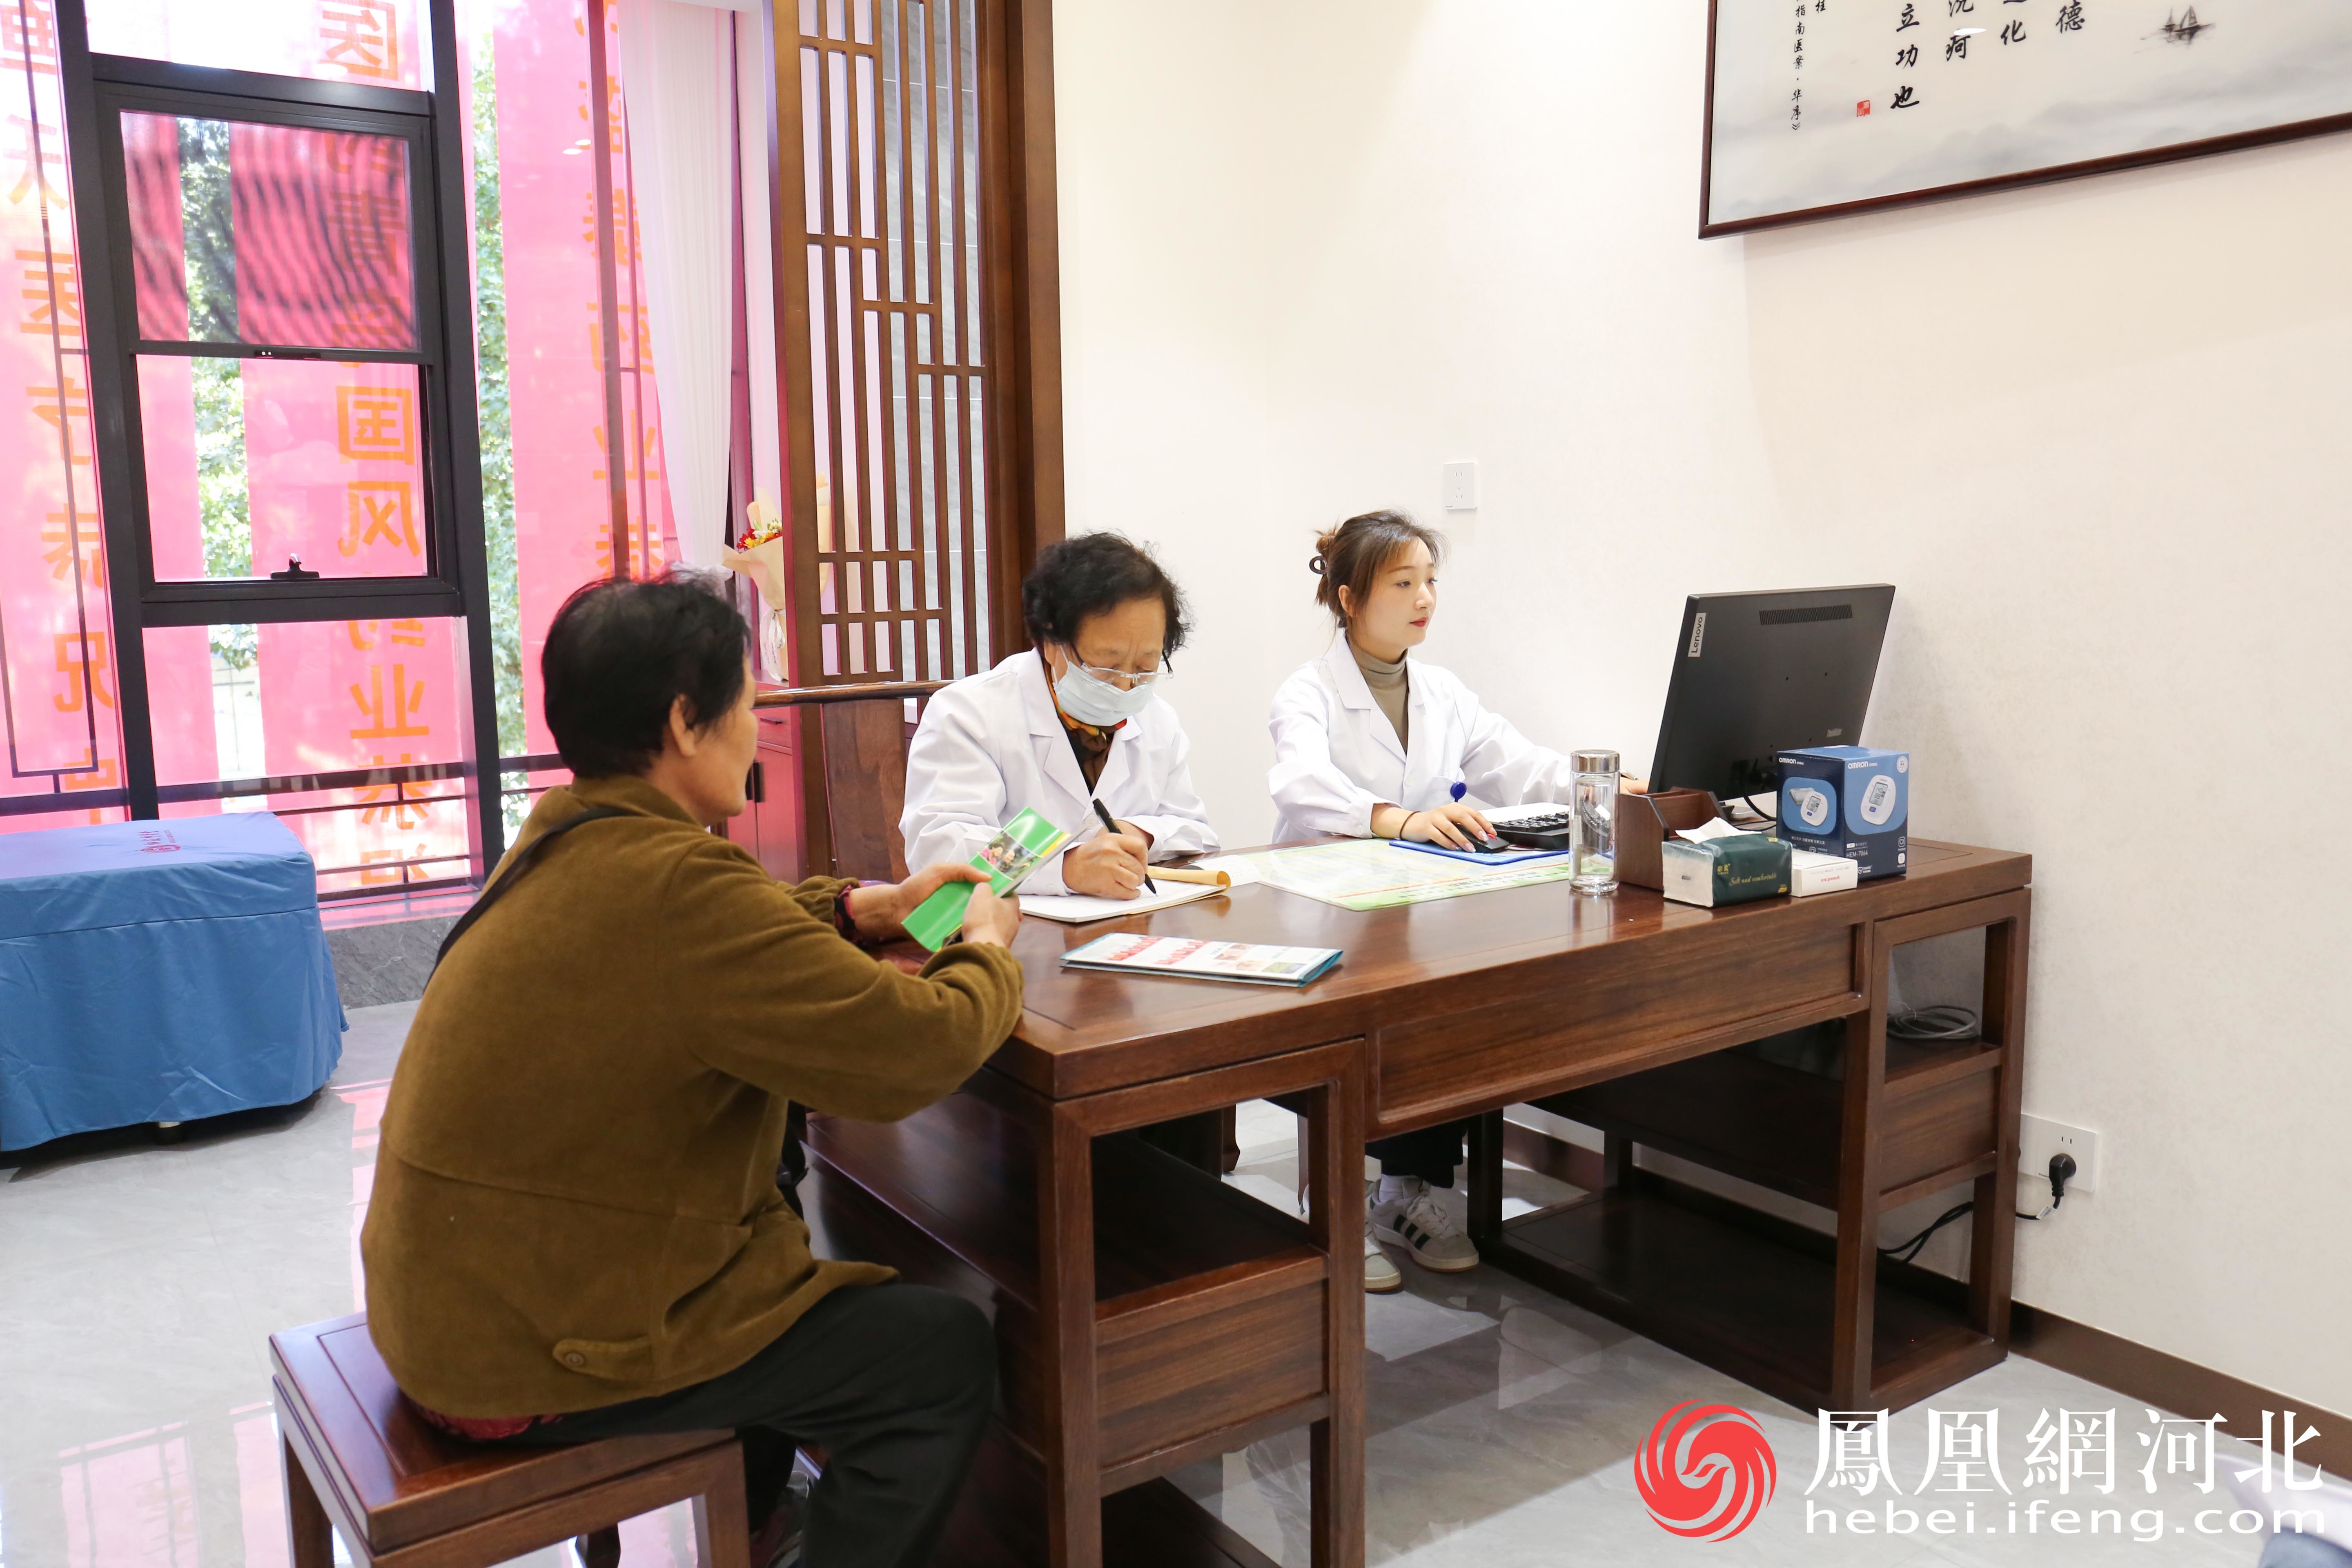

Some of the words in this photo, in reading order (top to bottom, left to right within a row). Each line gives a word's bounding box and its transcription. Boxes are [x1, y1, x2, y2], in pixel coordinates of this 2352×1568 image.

[2000, 0, 2027, 45] 化
[2056, 0, 2085, 33] 德
[1890, 3, 1920, 109] 立功也
[1691, 617, 1702, 653] Lenovo
[1848, 761, 1869, 769] OMRON
[1846, 850, 1868, 858] HEM-7064
[1728, 877, 1740, 886] Soft
